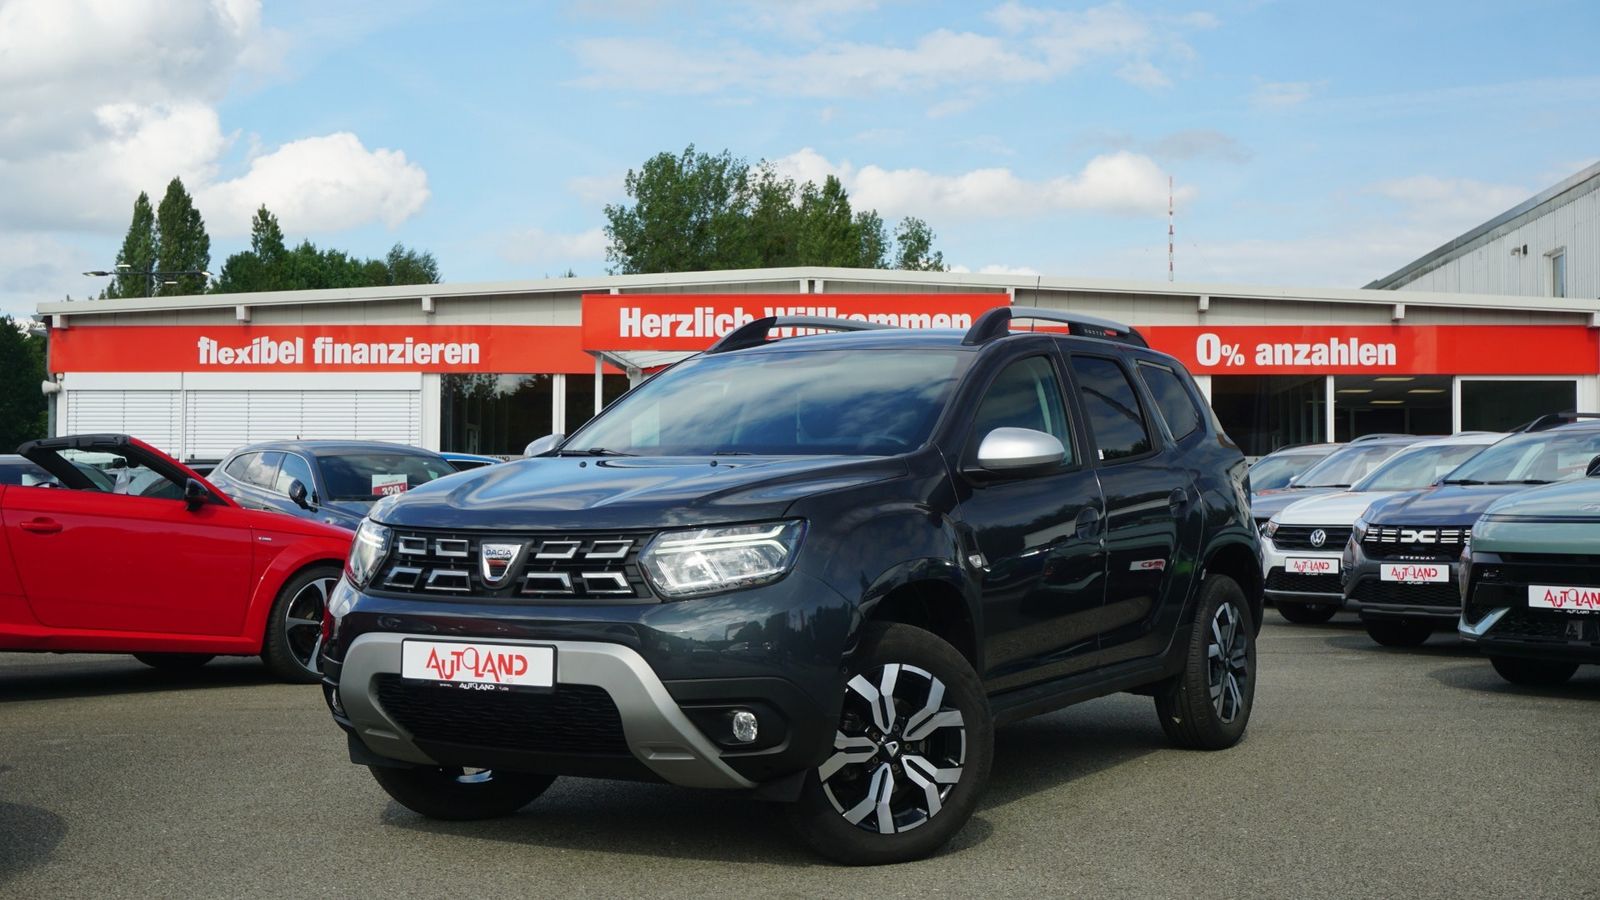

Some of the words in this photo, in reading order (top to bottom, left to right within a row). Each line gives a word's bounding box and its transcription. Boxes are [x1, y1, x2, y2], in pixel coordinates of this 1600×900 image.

[619, 307, 756, 339] Herzlich
[197, 336, 304, 365] flexibel
[312, 337, 480, 365] finanzieren
[1195, 333, 1246, 366] 0%
[1255, 337, 1397, 366] anzahlen
